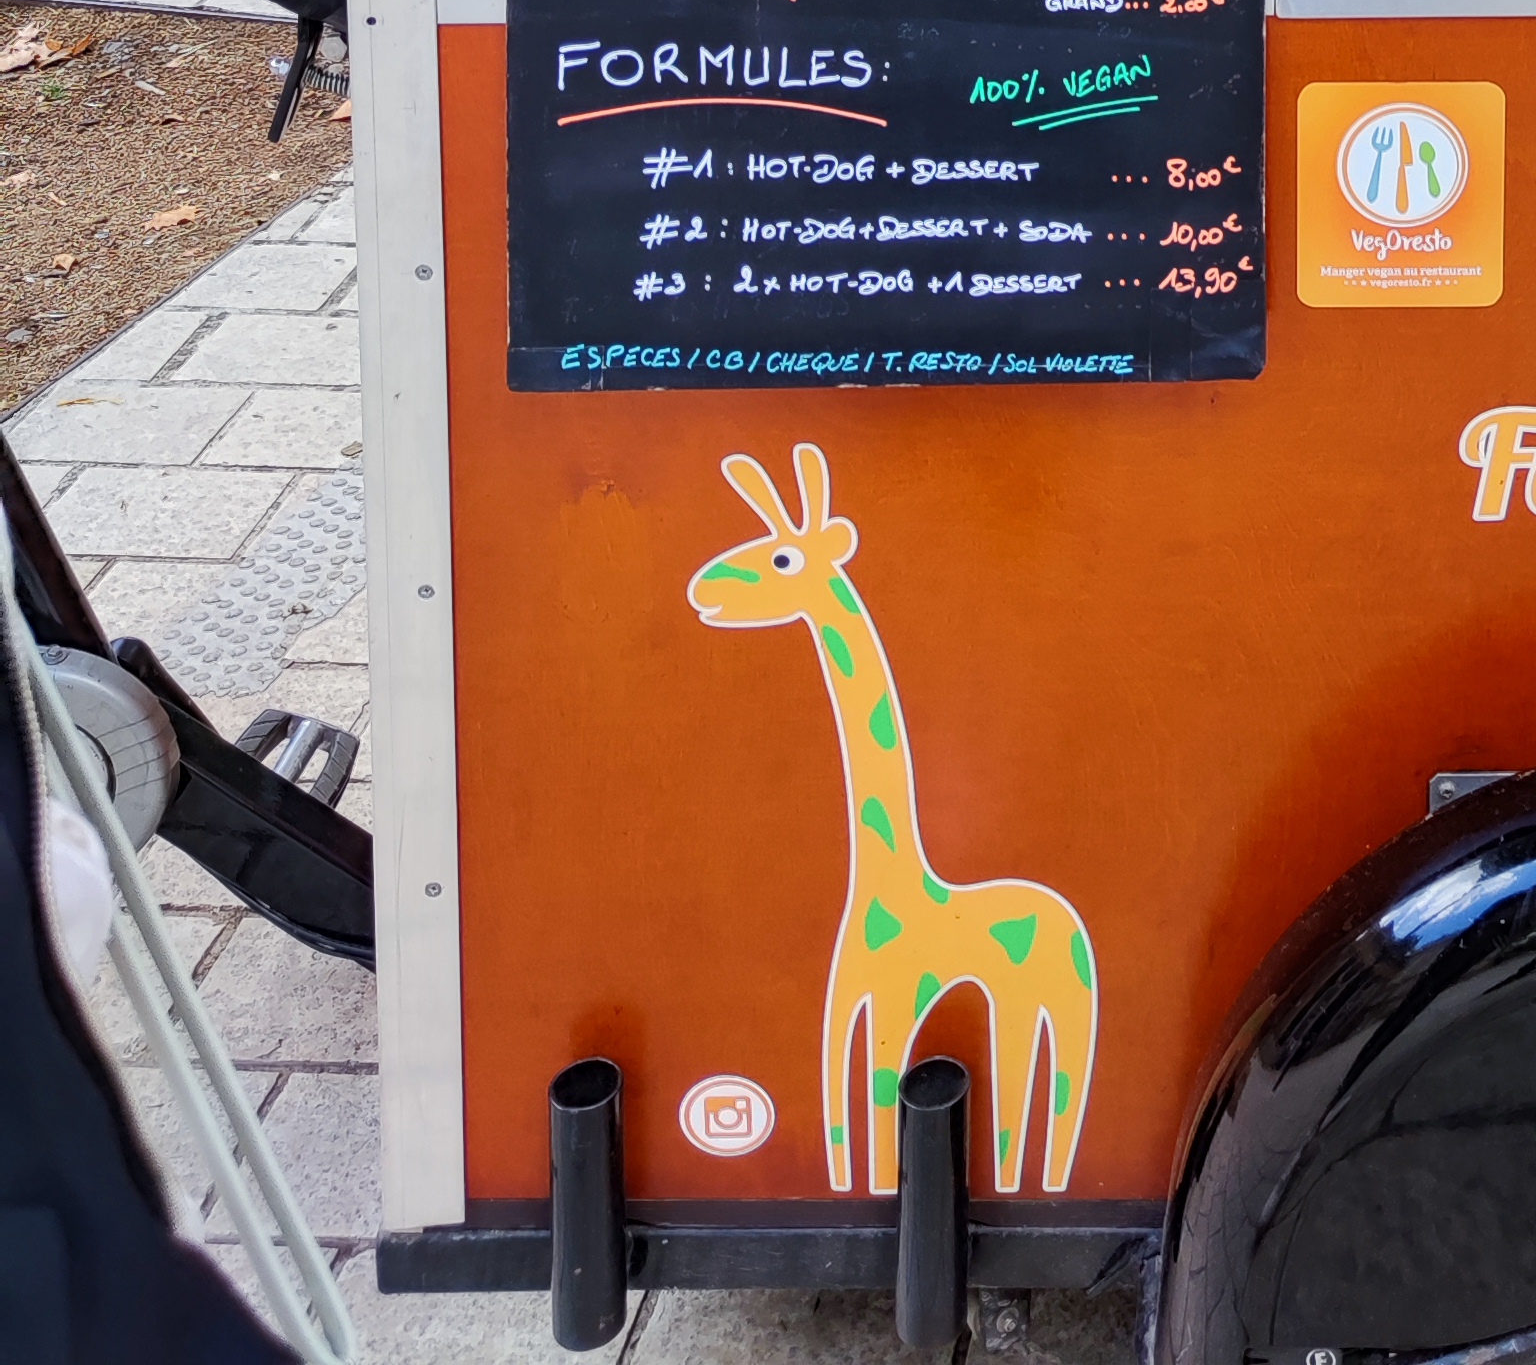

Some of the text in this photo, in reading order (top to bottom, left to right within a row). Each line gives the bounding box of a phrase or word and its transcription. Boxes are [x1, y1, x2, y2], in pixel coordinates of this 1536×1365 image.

[968, 53, 1152, 105] 100% VEGAN
[746, 153, 875, 184] HOT-DOG
[911, 157, 1039, 185] DESSERT
[1018, 218, 1093, 244] SODA
[1350, 228, 1453, 261] VegOresto
[789, 268, 914, 297] HOT-DOG
[968, 273, 1082, 298] DESSERT
[1320, 266, 1365, 279] Manger
[1368, 268, 1402, 279] vegan
[1420, 266, 1482, 277] restaurant
[1370, 278, 1432, 288] vegoresto.fr
[907, 352, 983, 373] RESTO
[1004, 352, 1038, 375] SOL
[1044, 352, 1135, 375] VIOLETTE
